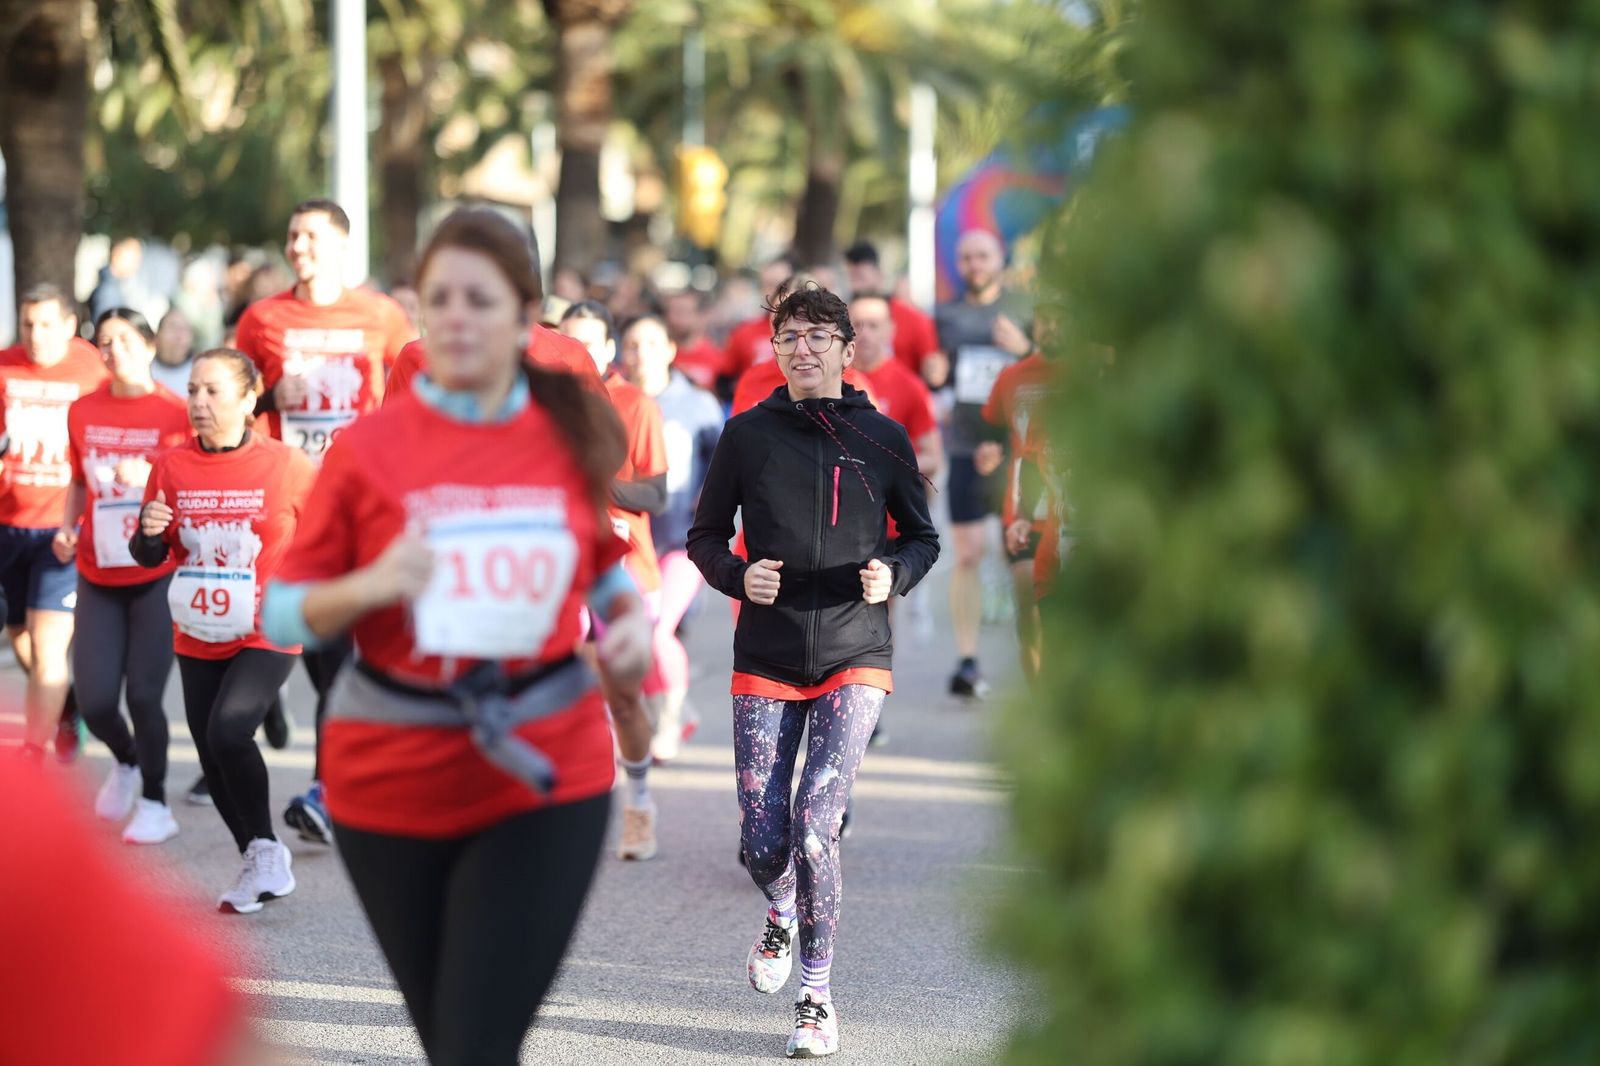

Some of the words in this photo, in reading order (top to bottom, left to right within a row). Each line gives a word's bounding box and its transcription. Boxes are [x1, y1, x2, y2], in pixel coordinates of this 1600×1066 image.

[177, 498, 218, 509] CIUDAD
[448, 546, 556, 603] 100
[190, 587, 231, 617] 49
